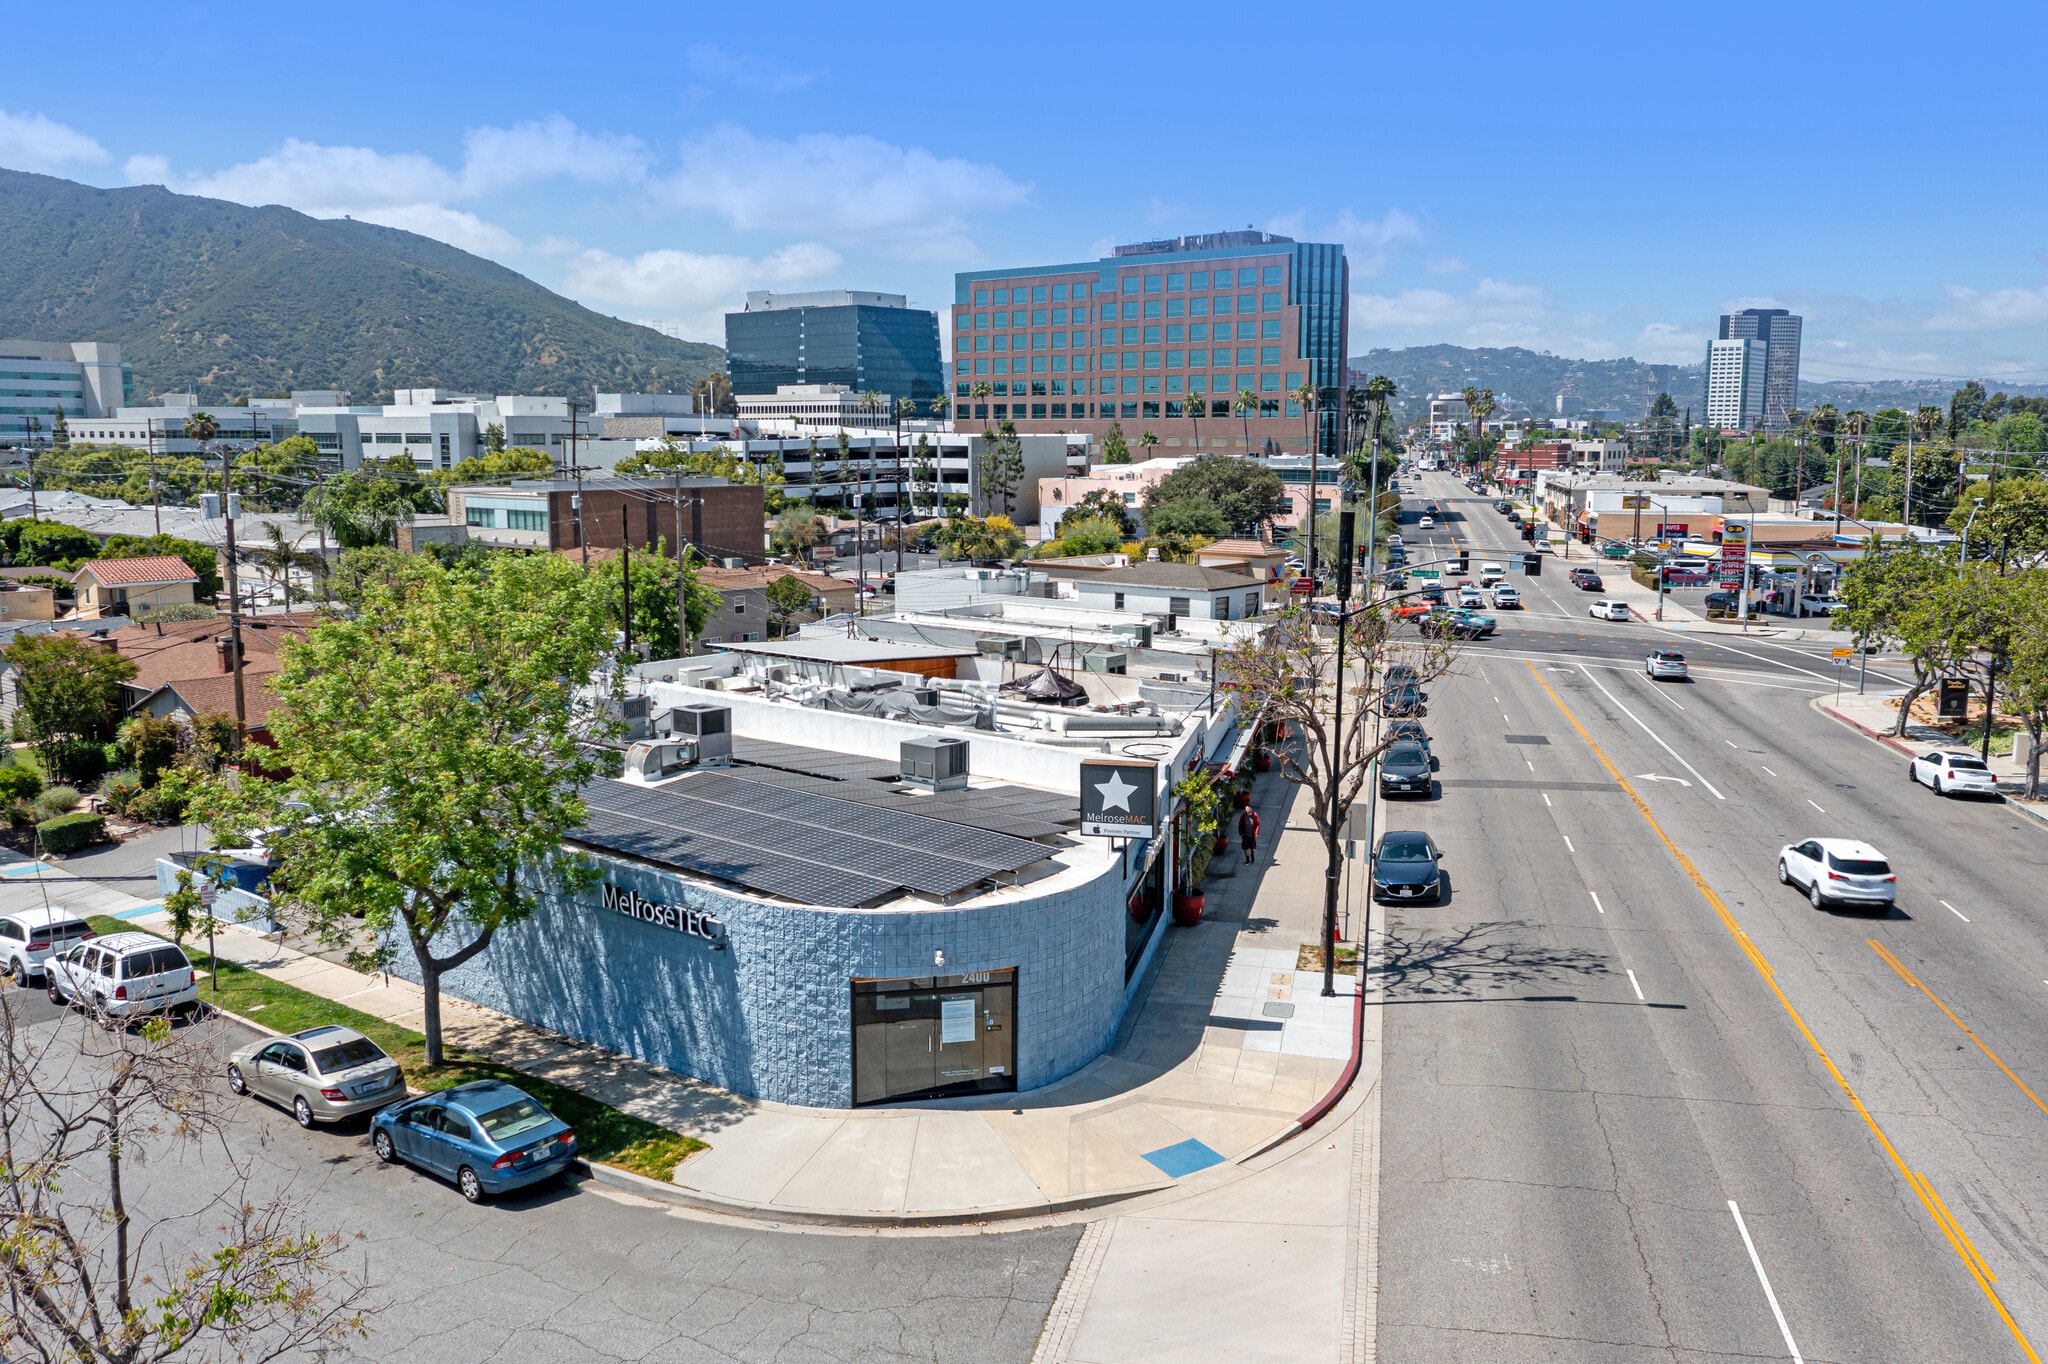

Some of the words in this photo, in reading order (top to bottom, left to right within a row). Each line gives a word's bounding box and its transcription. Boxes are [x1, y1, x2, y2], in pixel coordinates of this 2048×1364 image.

[1086, 812, 1146, 824] MelroseMAC
[602, 883, 717, 939] MelroseTEC
[961, 972, 990, 984] 2400
